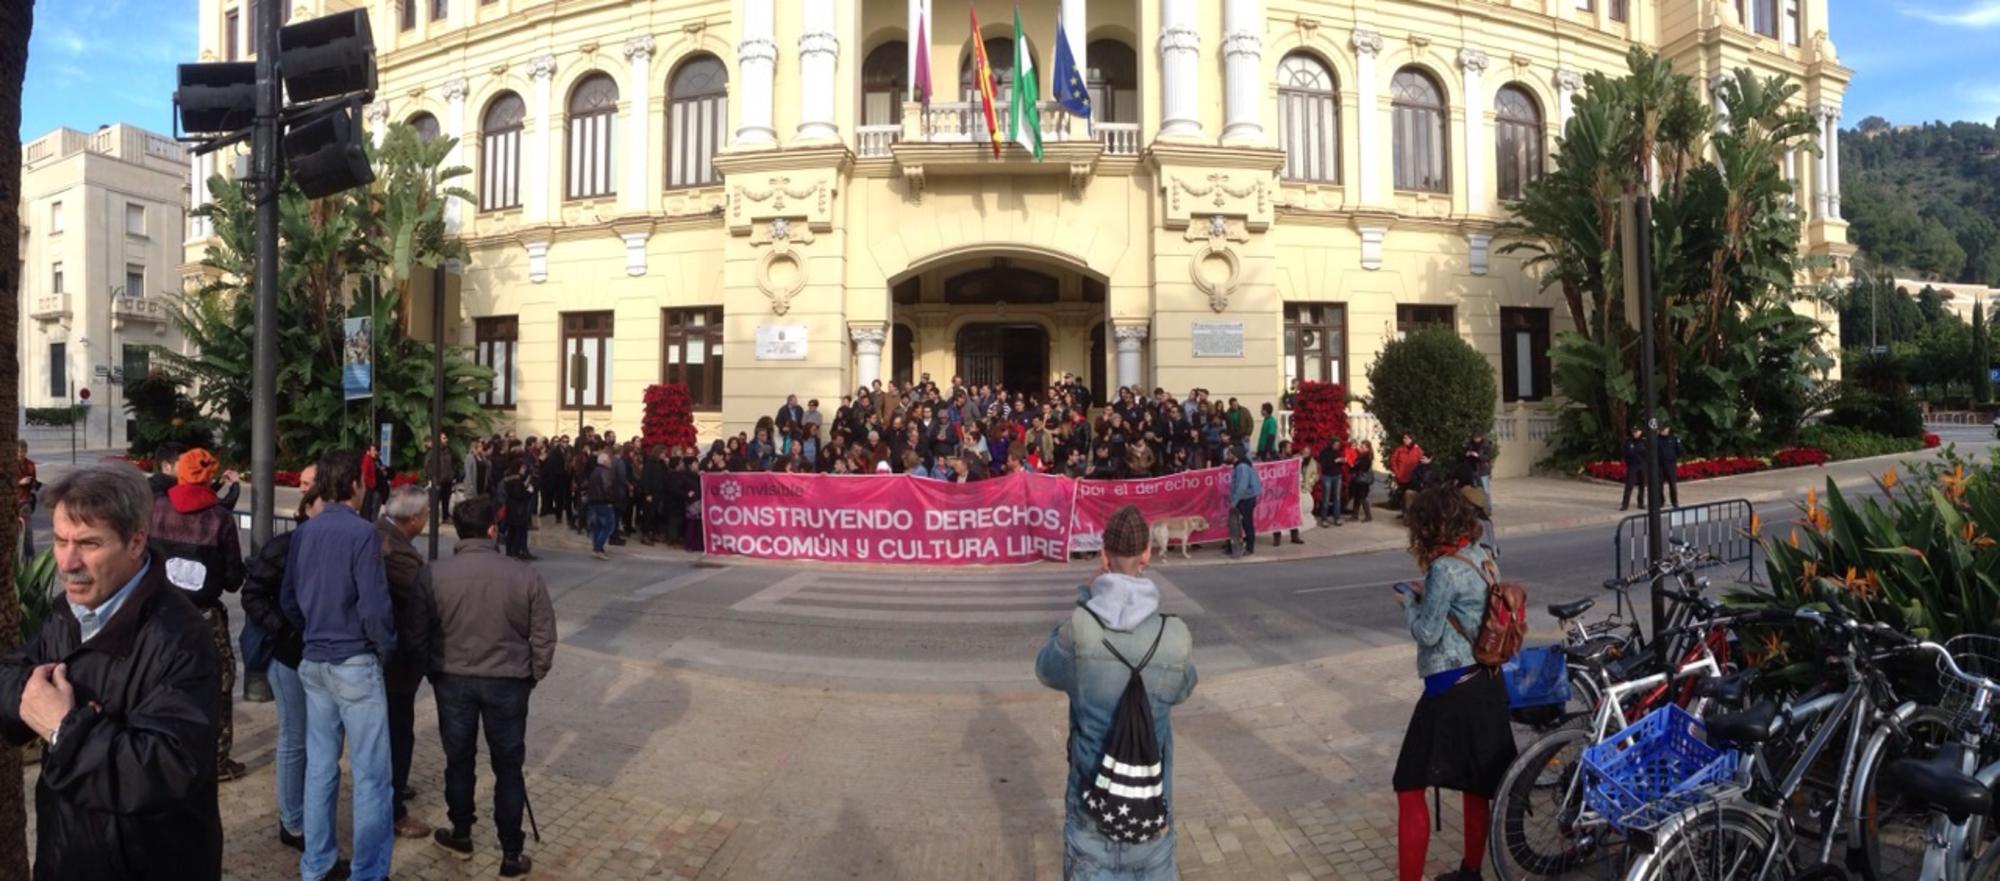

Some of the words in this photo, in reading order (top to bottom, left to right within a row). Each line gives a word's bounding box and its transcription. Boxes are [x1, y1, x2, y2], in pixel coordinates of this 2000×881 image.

[742, 483, 805, 497] invisible
[1080, 484, 1104, 498] por
[1114, 483, 1128, 496] el
[1135, 477, 1200, 495] derecho
[1204, 475, 1214, 486] a
[1218, 471, 1232, 484] la
[708, 504, 913, 531] CONSTRUYENDO
[925, 504, 1065, 535] DERECHOS,
[710, 533, 848, 558] PROCOMÚN
[877, 536, 1000, 560] CULTURA
